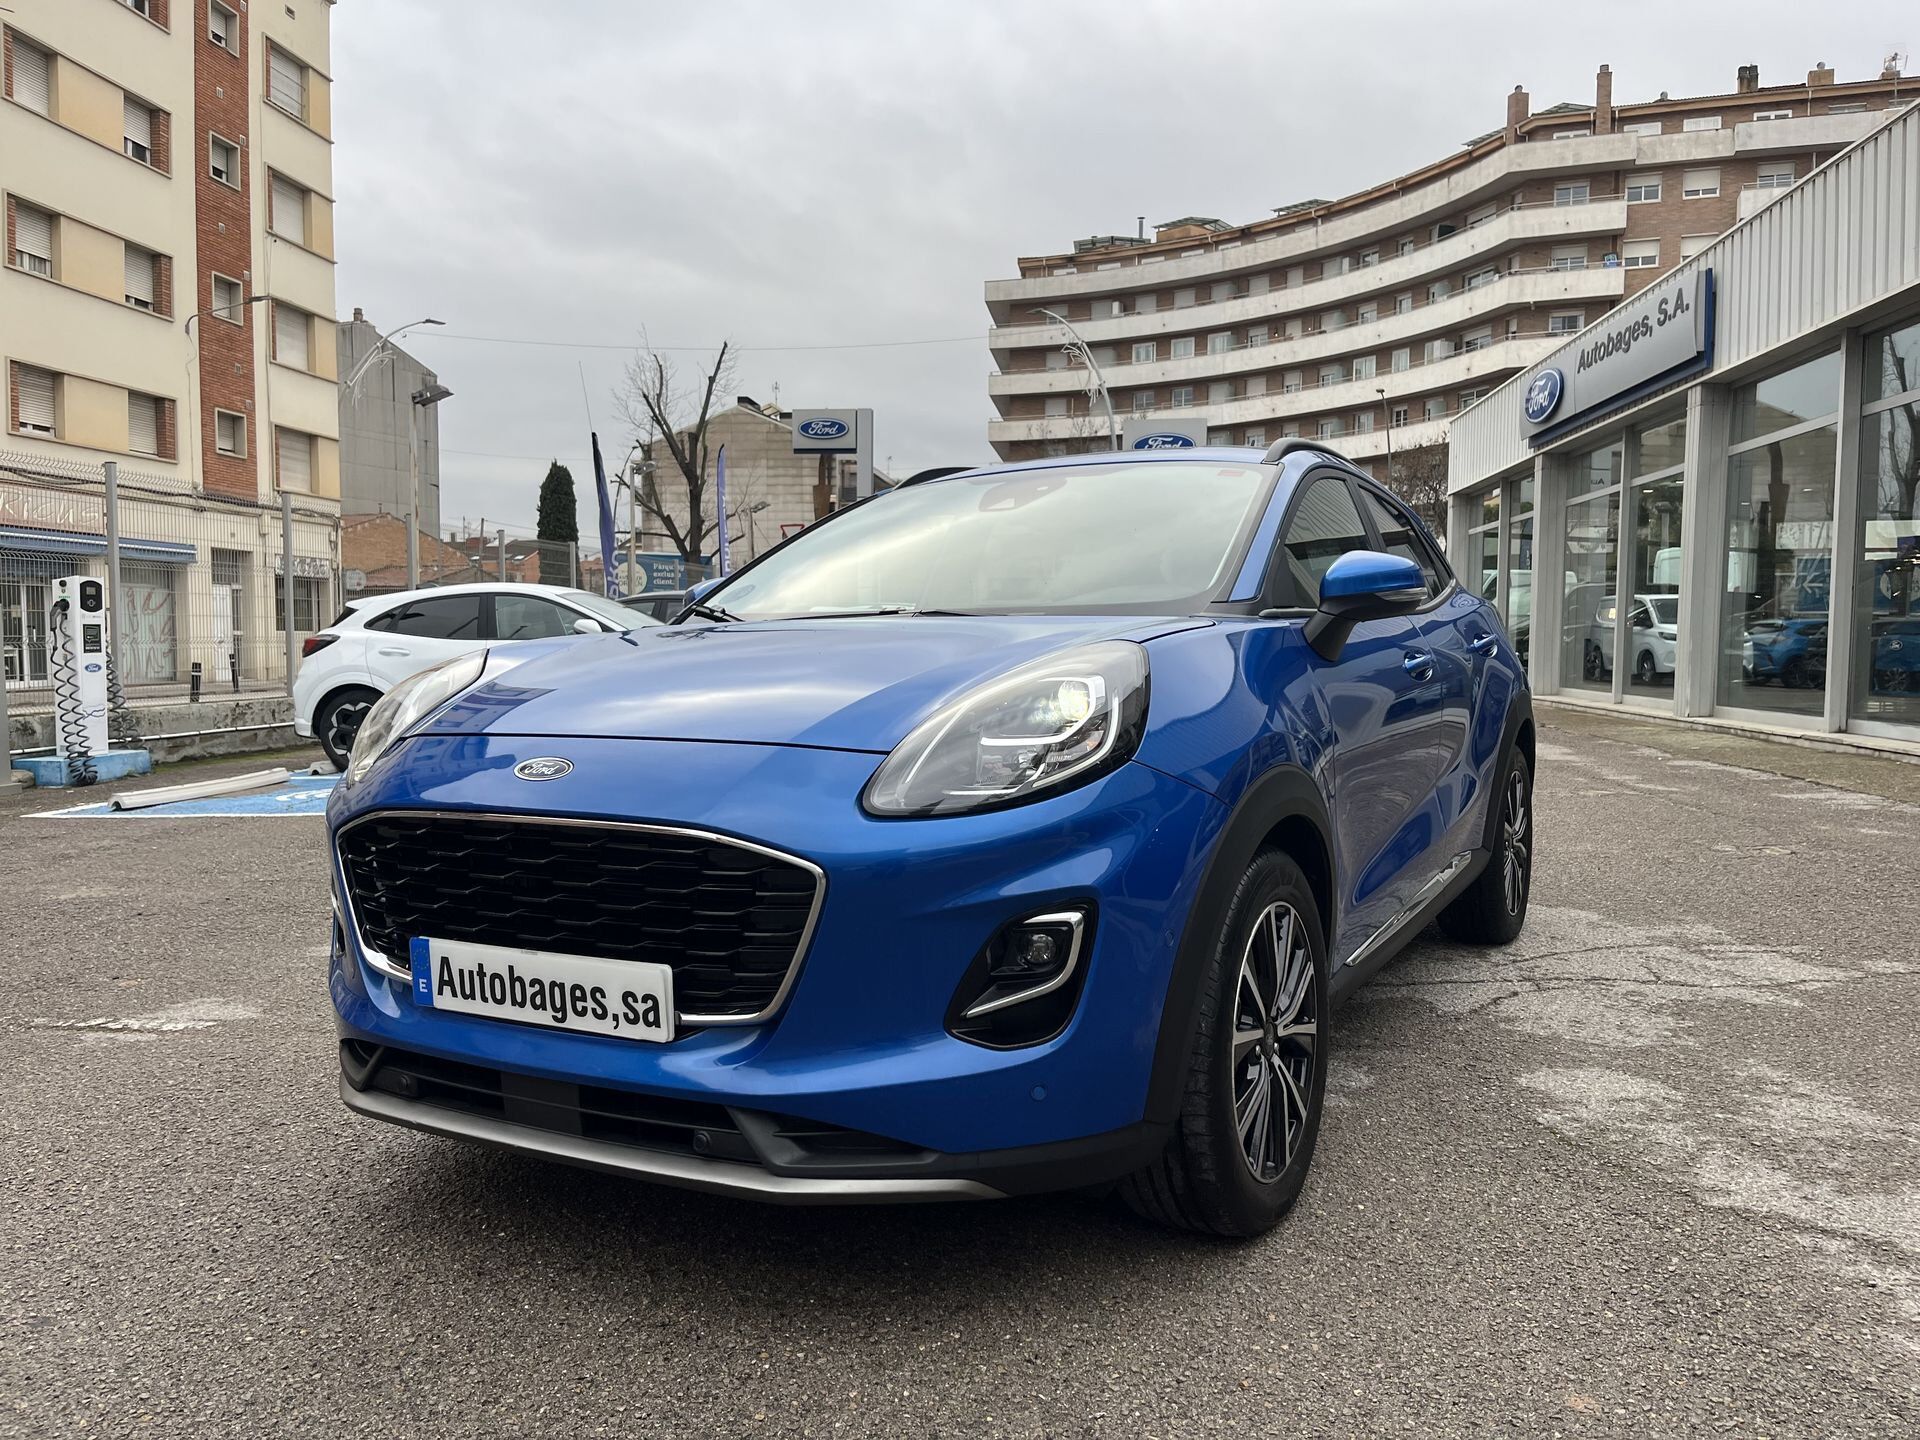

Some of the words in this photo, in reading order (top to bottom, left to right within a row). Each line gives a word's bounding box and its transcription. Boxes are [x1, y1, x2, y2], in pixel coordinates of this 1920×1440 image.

[1577, 315, 1653, 374] Autobages,
[1657, 287, 1690, 328] S.A.
[1528, 377, 1552, 415] Ford
[808, 421, 839, 435] Ford
[524, 761, 560, 775] Ford
[419, 978, 428, 993] E
[437, 956, 662, 1030] Autobages,sa
